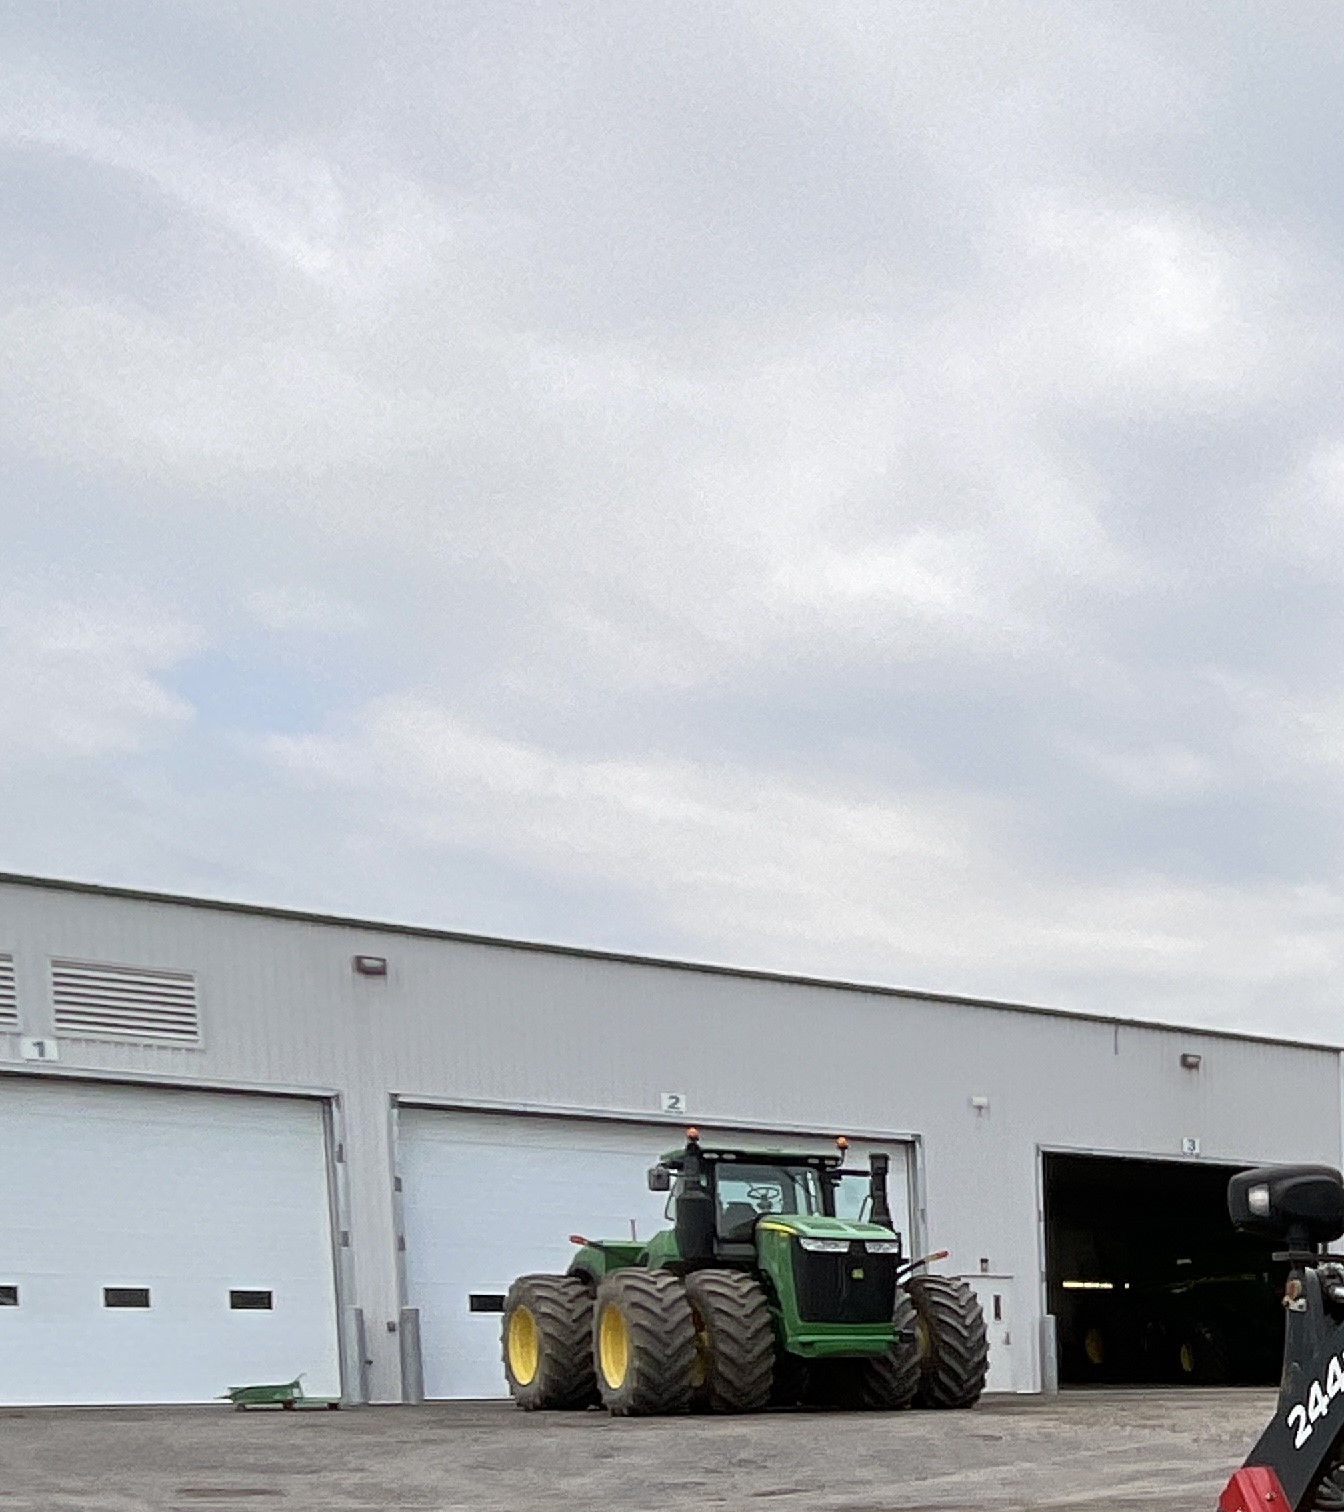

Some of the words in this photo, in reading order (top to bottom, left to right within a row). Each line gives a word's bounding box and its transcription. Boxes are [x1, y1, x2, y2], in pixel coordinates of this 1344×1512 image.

[32, 1040, 46, 1058] 1
[667, 1095, 680, 1110] 2
[1186, 1138, 1196, 1152] 3
